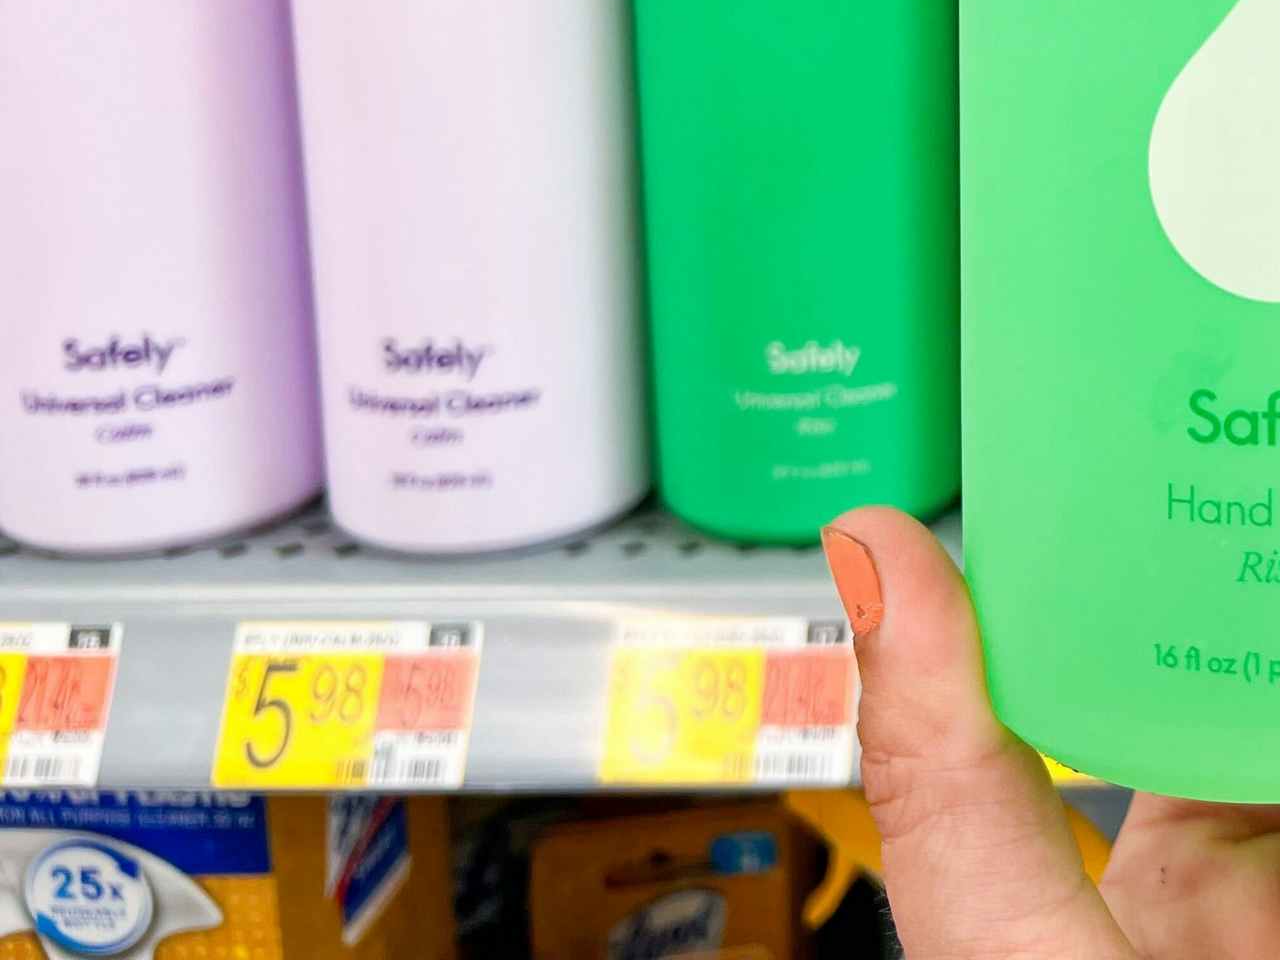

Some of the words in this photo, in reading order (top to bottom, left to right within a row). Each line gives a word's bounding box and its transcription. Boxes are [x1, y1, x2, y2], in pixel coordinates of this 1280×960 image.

[1168, 483, 1273, 526] Hand
[1154, 643, 1179, 669] 16
[1184, 645, 1201, 672] fl
[1207, 655, 1238, 675] oz
[1243, 650, 1261, 683] (1
